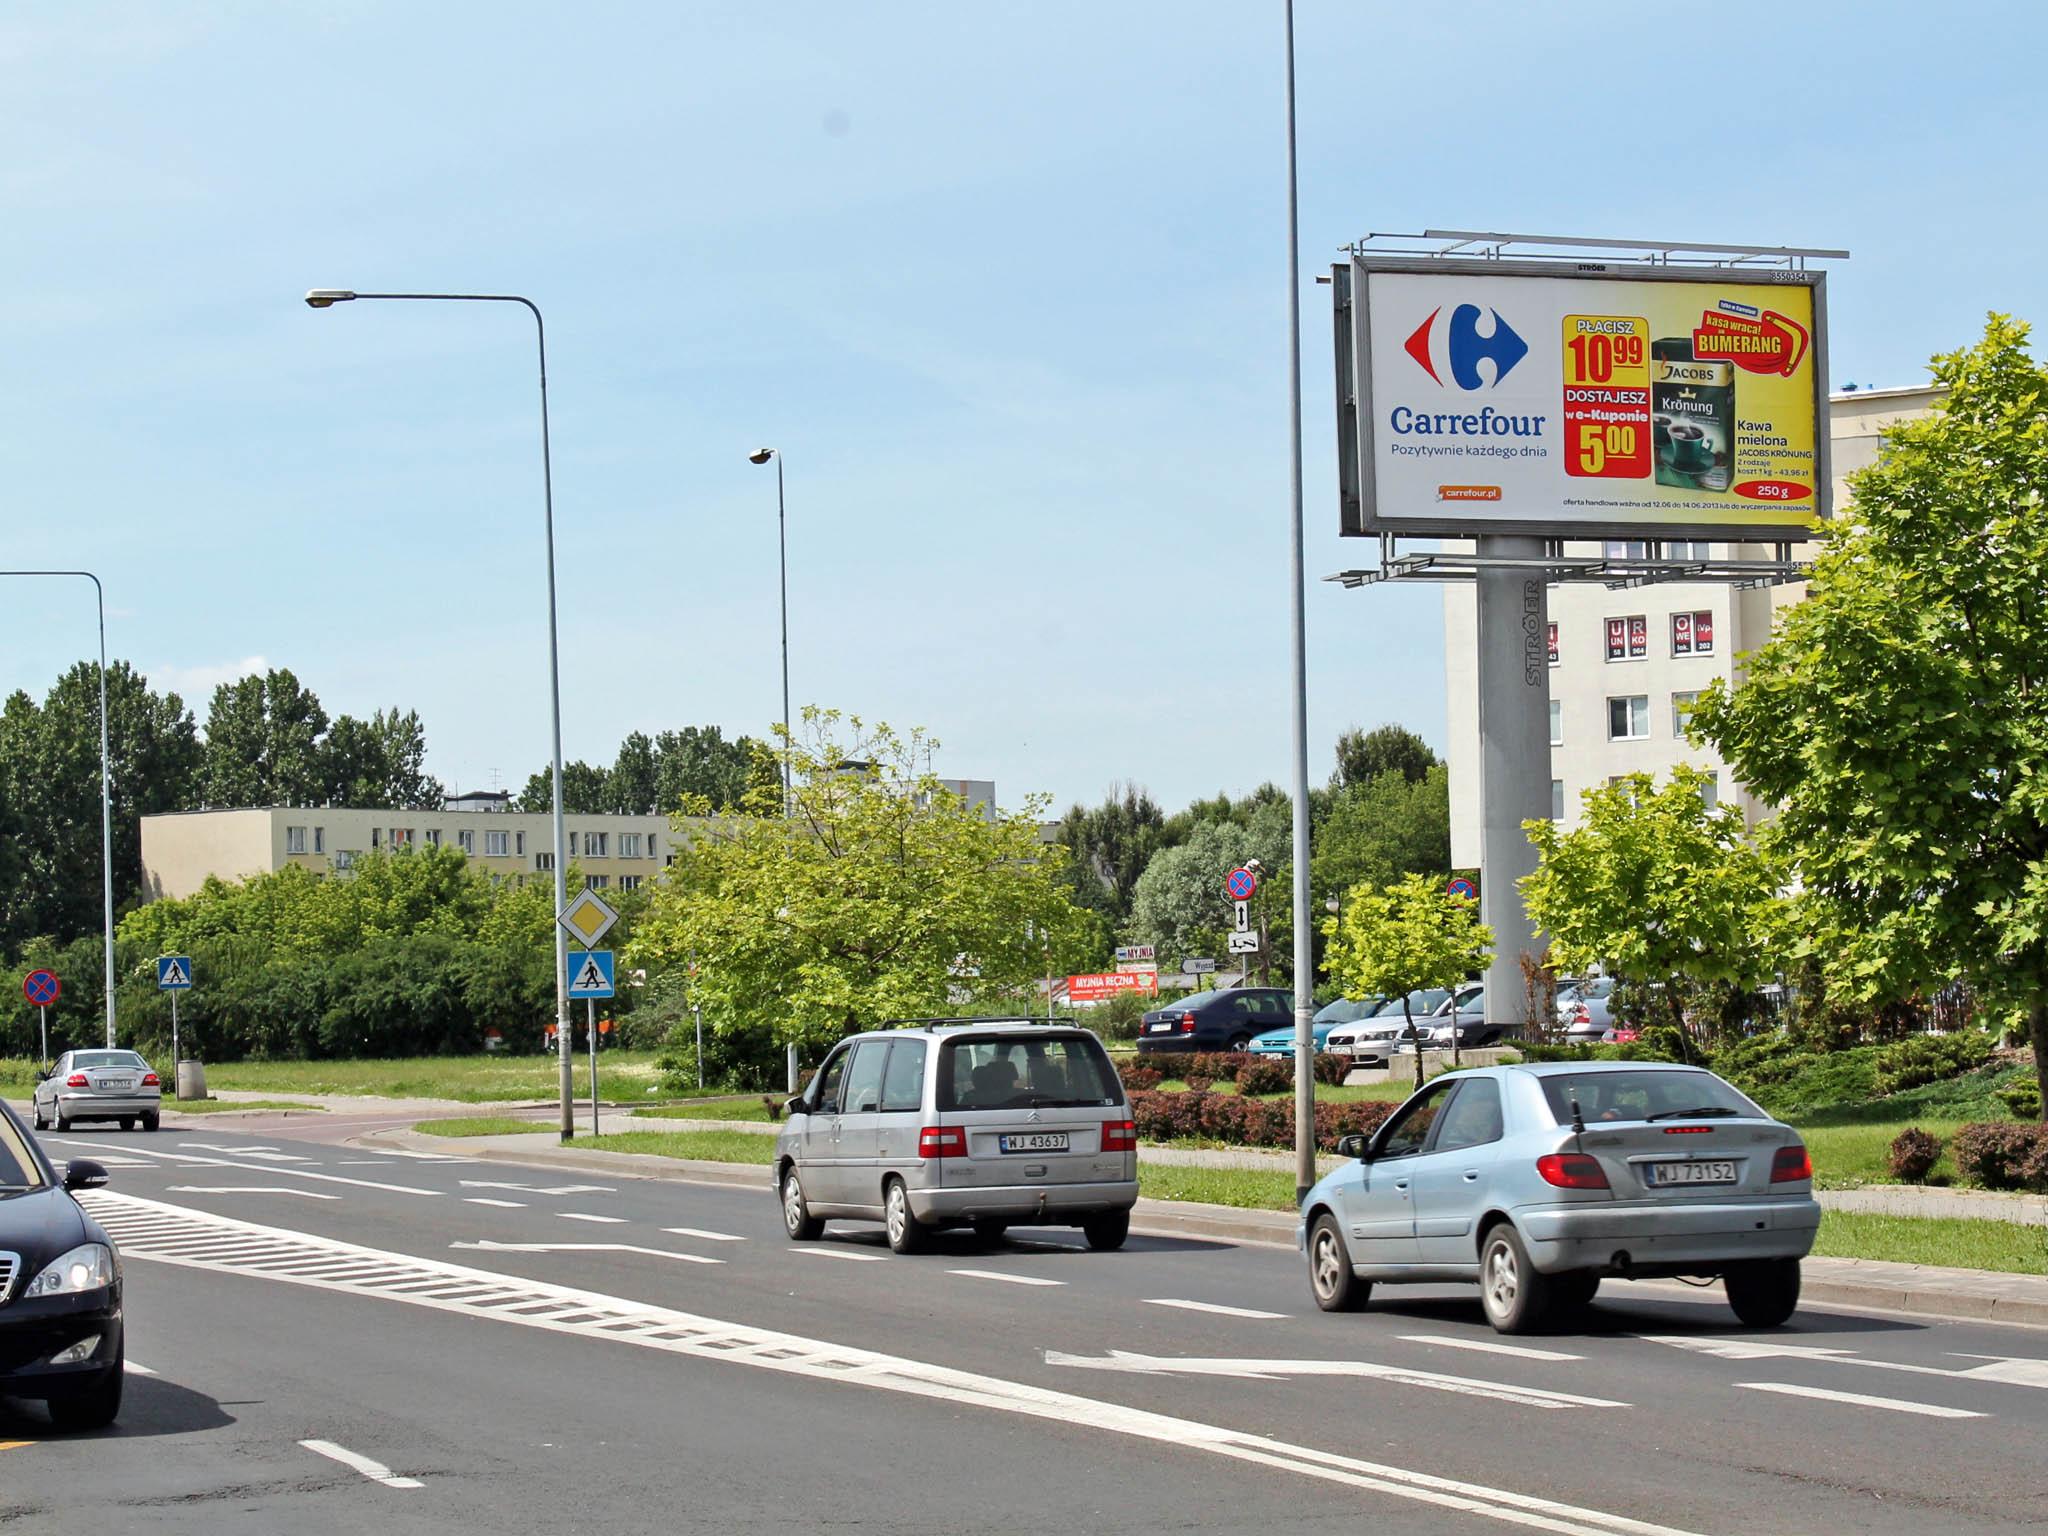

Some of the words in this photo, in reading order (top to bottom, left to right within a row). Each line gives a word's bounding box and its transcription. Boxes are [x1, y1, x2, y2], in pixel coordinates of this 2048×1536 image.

[1770, 271, 1806, 281] 8550354
[1577, 320, 1635, 334] PŁACISZ
[1706, 314, 1729, 329] kasa
[1730, 320, 1762, 335] wraca!
[1698, 334, 1781, 353] BUMERANG
[1661, 366, 1714, 380] JACOBS
[1566, 390, 1647, 404] DOSTAJESZ
[1662, 398, 1713, 416] Krönung
[1391, 406, 1546, 436] Carrefour
[1576, 409, 1649, 423] e-Kuponie
[1738, 420, 1772, 431] Kawa
[1738, 434, 1788, 446] mielona
[1391, 444, 1463, 457] Pozytywnie
[1466, 445, 1518, 459] każdego
[1520, 446, 1547, 457] dnia
[1738, 449, 1770, 457] JACOBS
[1771, 448, 1812, 459] KRÖNUNG
[1743, 459, 1771, 467] rodzaje
[1446, 488, 1497, 498] carrefour.pl
[1757, 486, 1780, 496] 250
[1781, 487, 1789, 499] g
[1585, 499, 1618, 507] handlowa
[1741, 504, 1782, 512] wyczerpania
[1522, 580, 1541, 687] STRÖER
[1127, 947, 1154, 959] MYJNIA
[1076, 977, 1105, 988] MYJNIA
[1008, 1136, 1025, 1148] WJ
[1030, 1135, 1066, 1148] 43637
[1656, 1165, 1678, 1181] WJ
[1682, 1163, 1733, 1180] 73152
